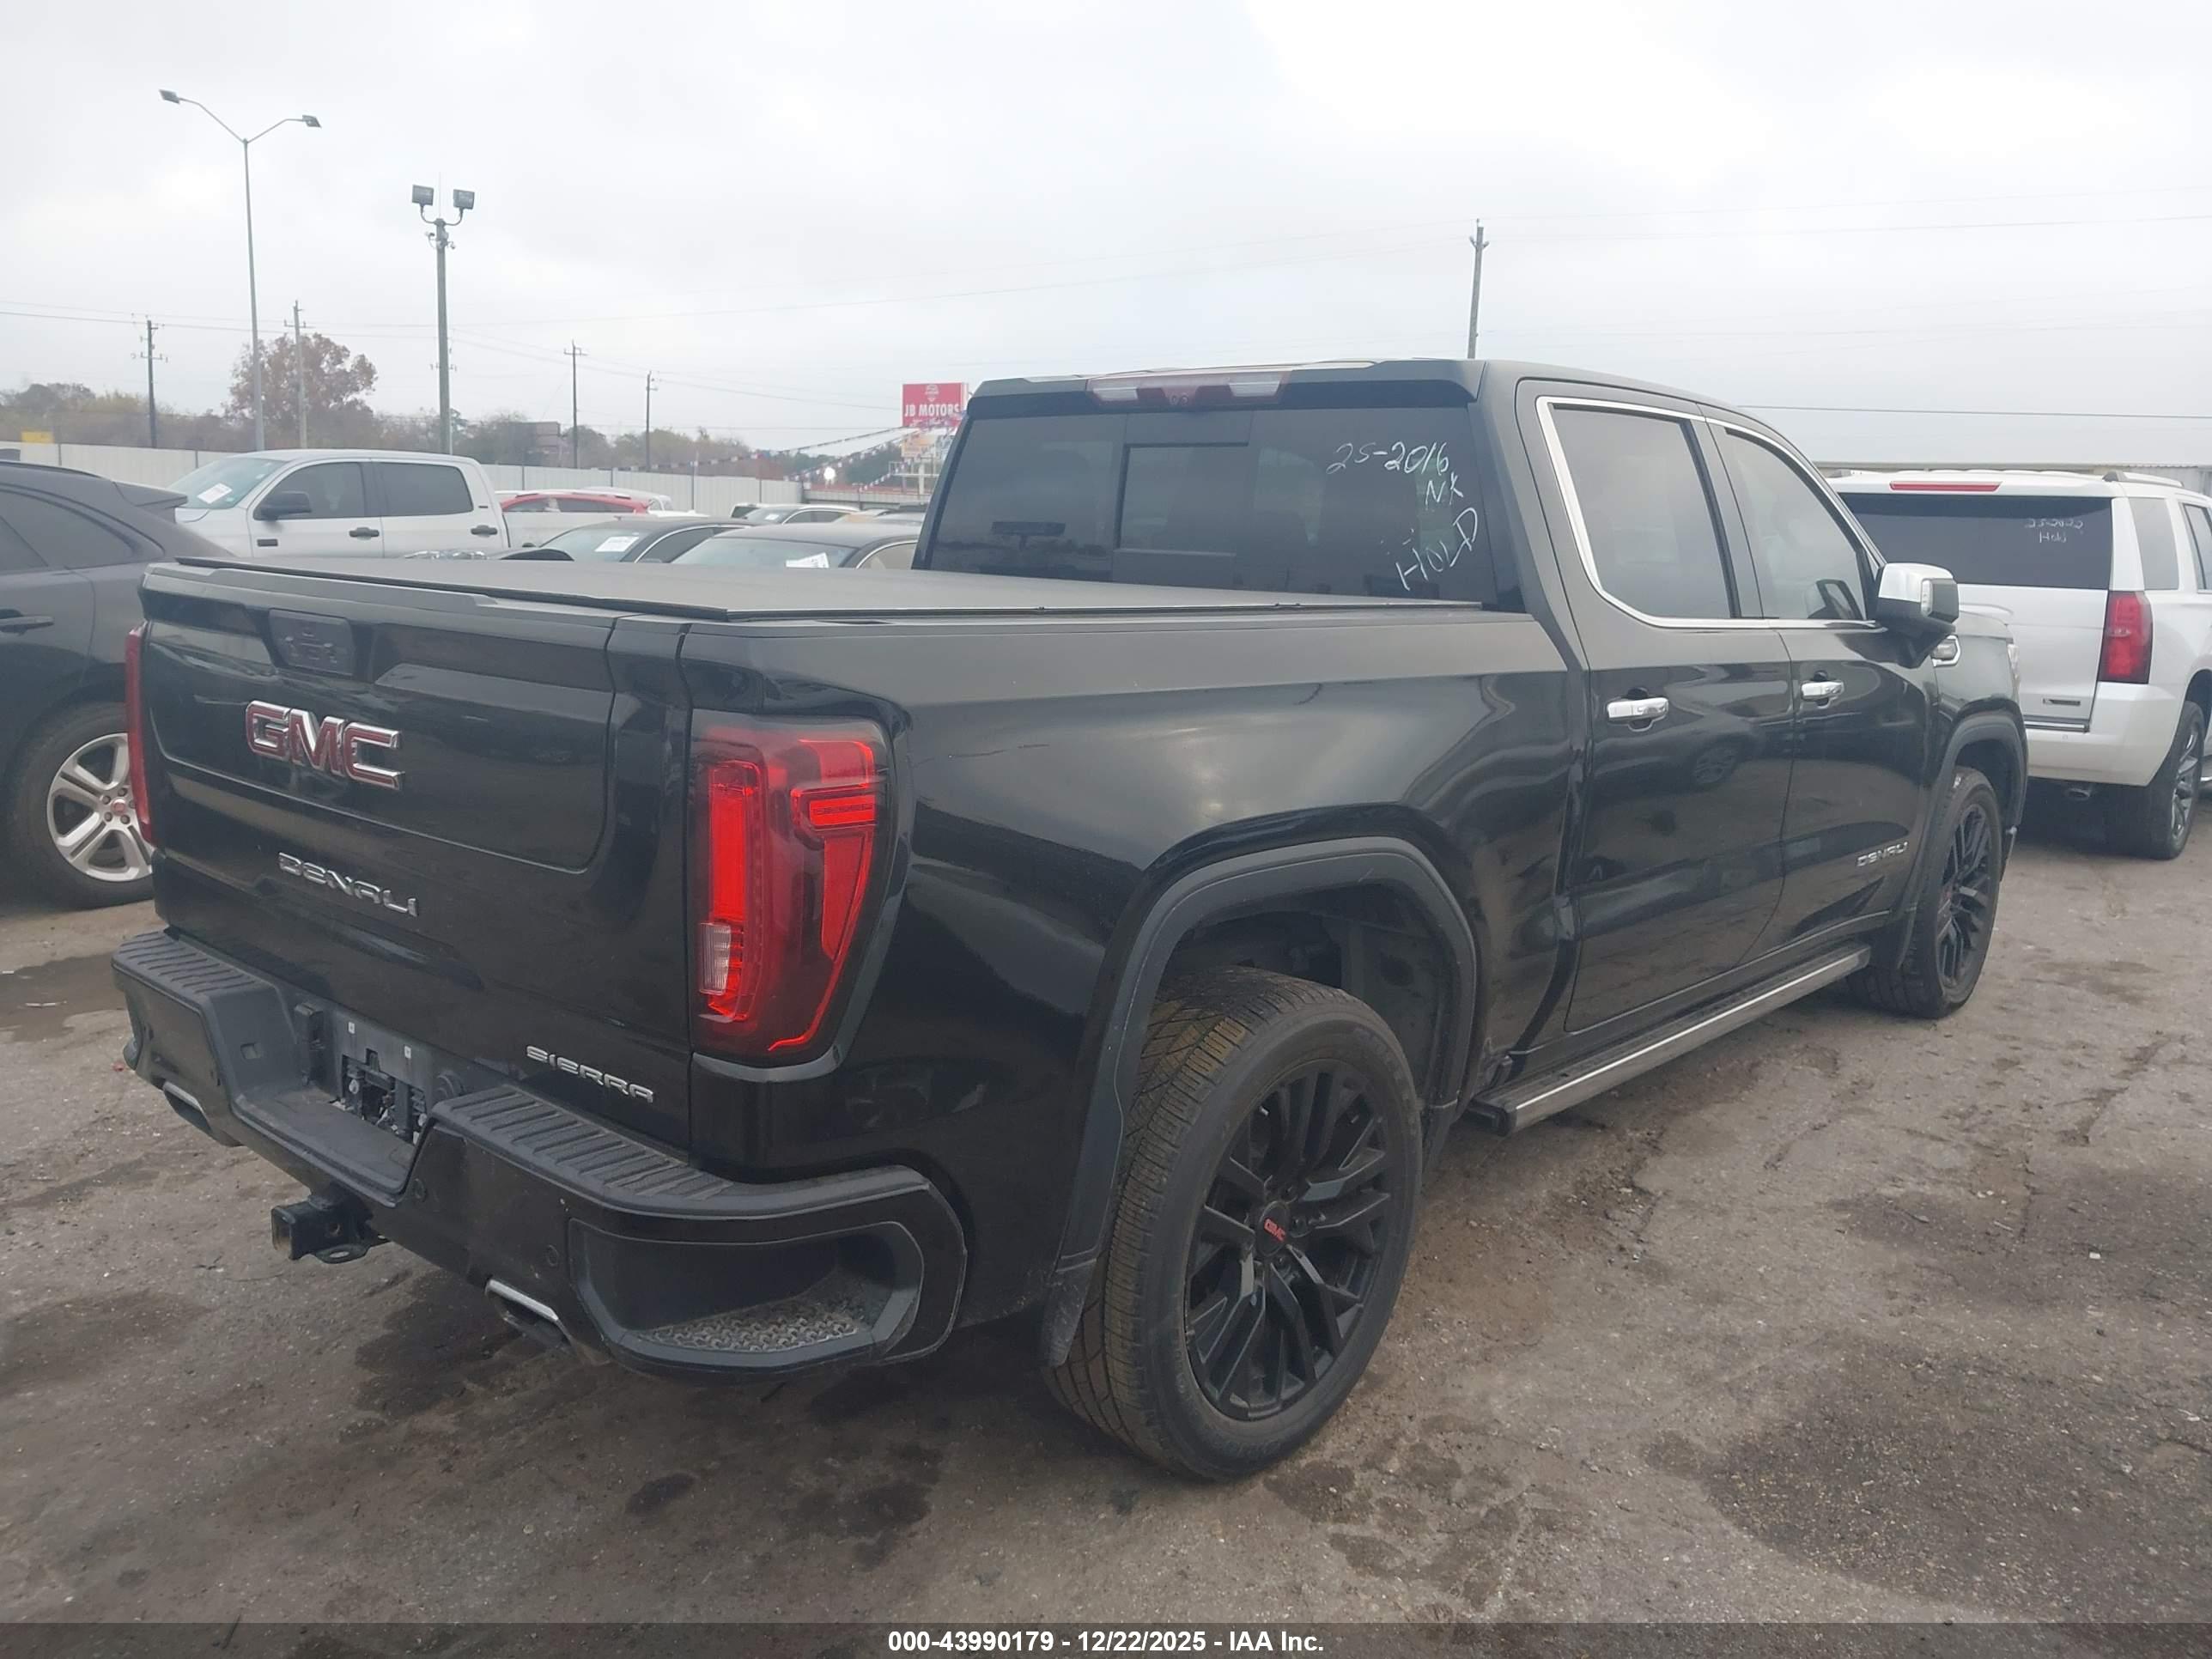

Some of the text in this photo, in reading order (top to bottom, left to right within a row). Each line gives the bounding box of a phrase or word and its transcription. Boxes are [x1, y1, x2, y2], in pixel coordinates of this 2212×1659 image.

[904, 403, 960, 417] JB MOTORS
[246, 700, 404, 790] GMC
[1857, 841, 1908, 866] DENALI
[278, 851, 419, 918] DENALI
[526, 1045, 654, 1103] SIERRA
